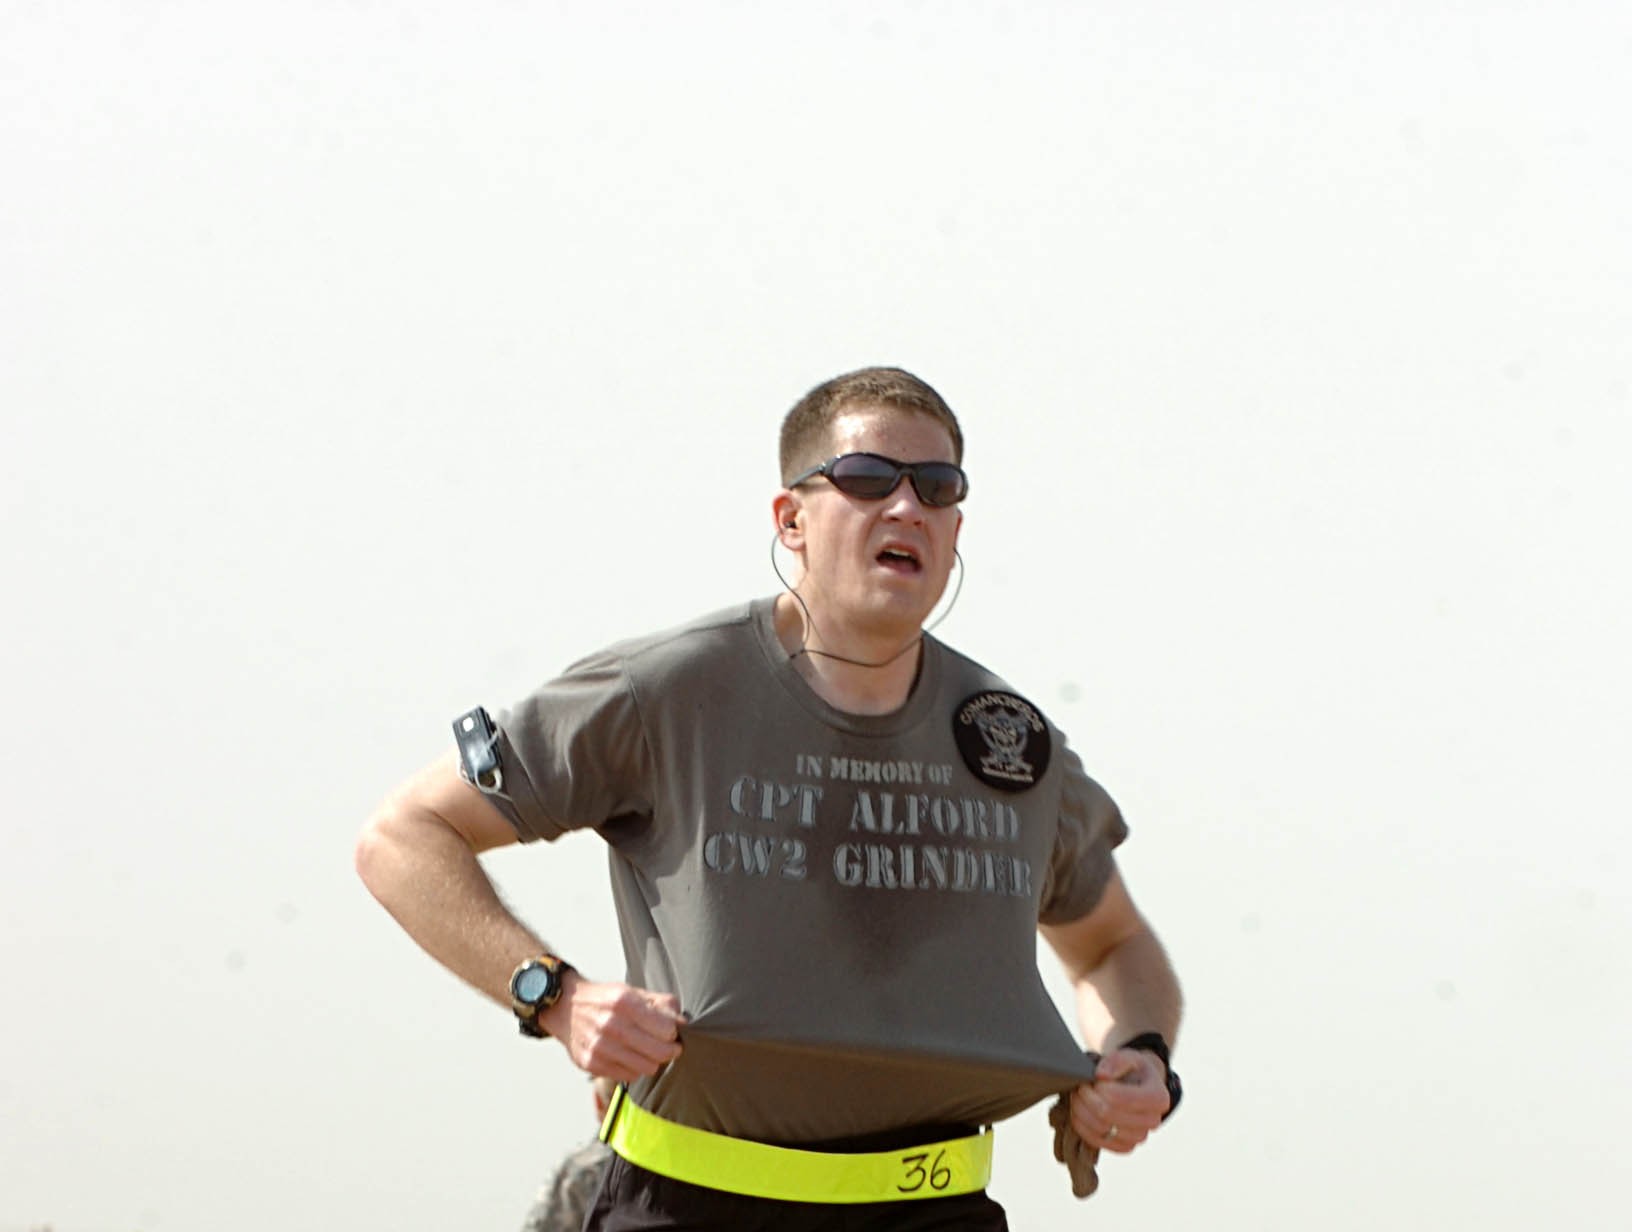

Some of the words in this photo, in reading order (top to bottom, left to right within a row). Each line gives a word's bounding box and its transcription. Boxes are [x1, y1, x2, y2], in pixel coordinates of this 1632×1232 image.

[796, 754, 822, 778] IN
[830, 757, 923, 784] MEMORY
[928, 766, 953, 785] OF
[730, 776, 824, 827] CPT
[850, 791, 1019, 840] ALFORD
[703, 832, 808, 879] CW2
[833, 843, 1032, 896] GRINDER
[897, 1149, 951, 1192] 36
